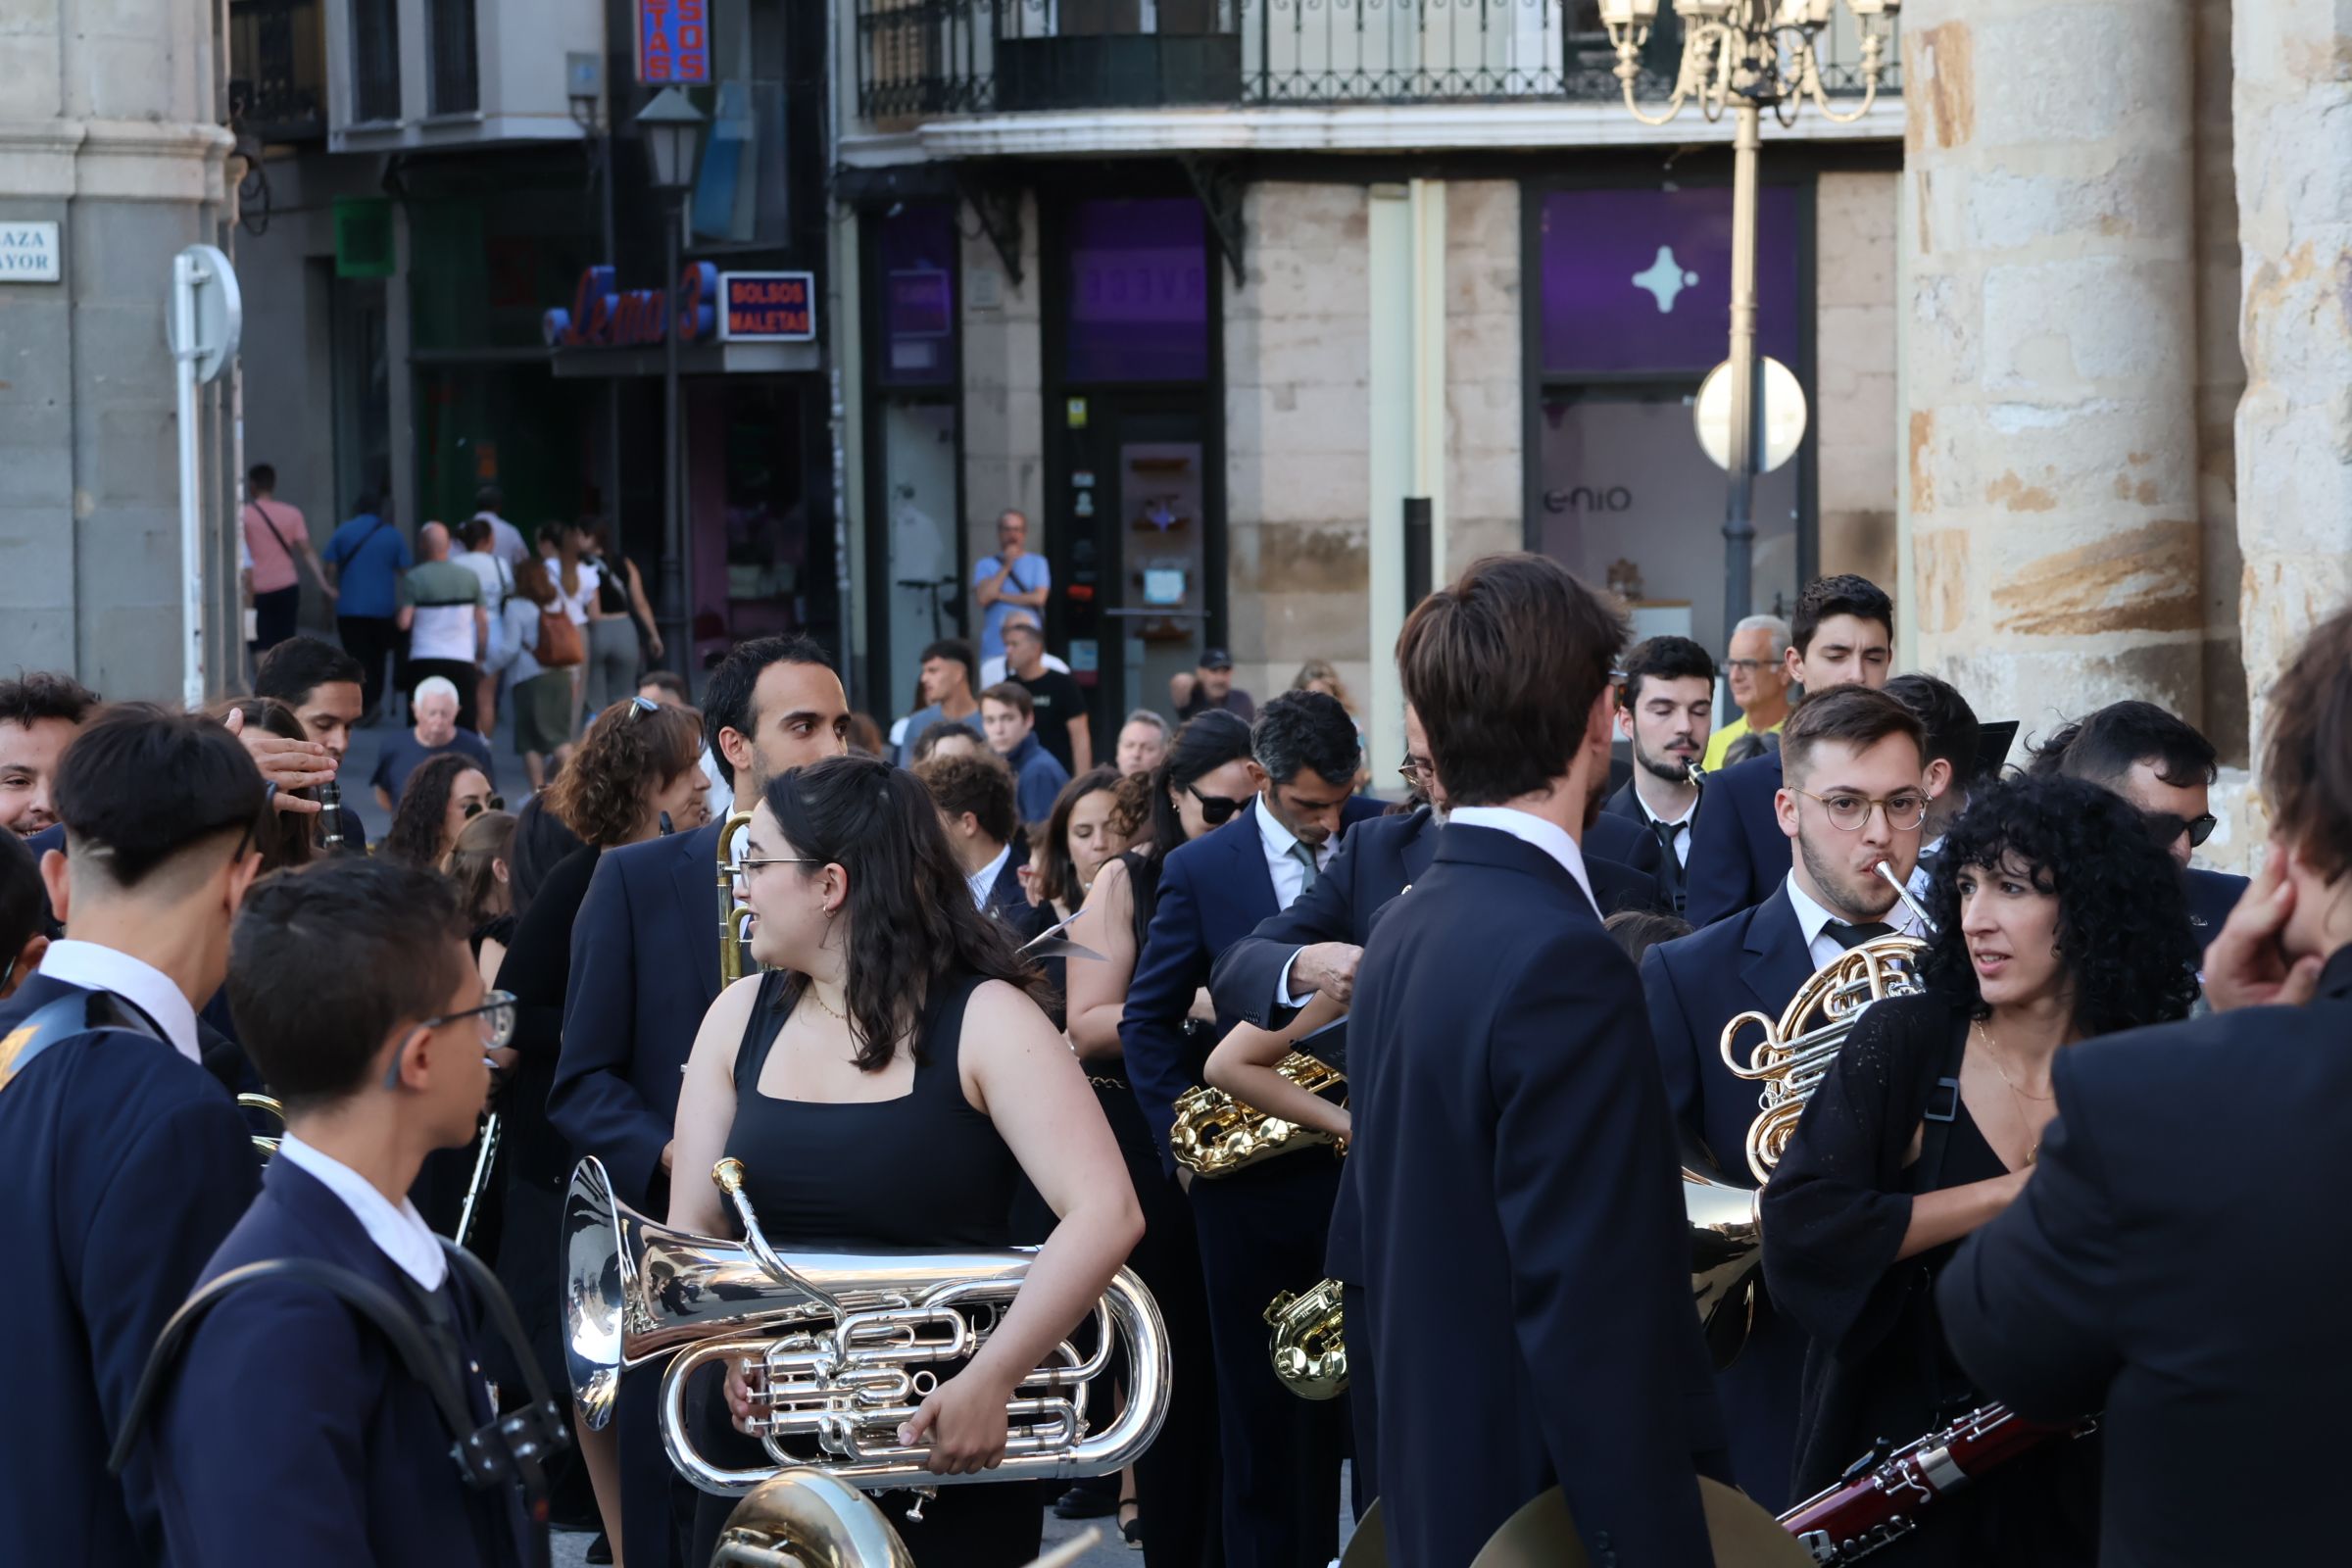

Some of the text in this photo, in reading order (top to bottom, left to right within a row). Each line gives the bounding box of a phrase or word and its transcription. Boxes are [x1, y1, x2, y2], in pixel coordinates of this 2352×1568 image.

[646, 0, 670, 78] TAS
[678, 0, 705, 78] SOS
[0, 230, 44, 248] AZA
[678, 261, 712, 342] 3
[731, 281, 805, 304] BOLSOS
[729, 311, 808, 332] MALETAS
